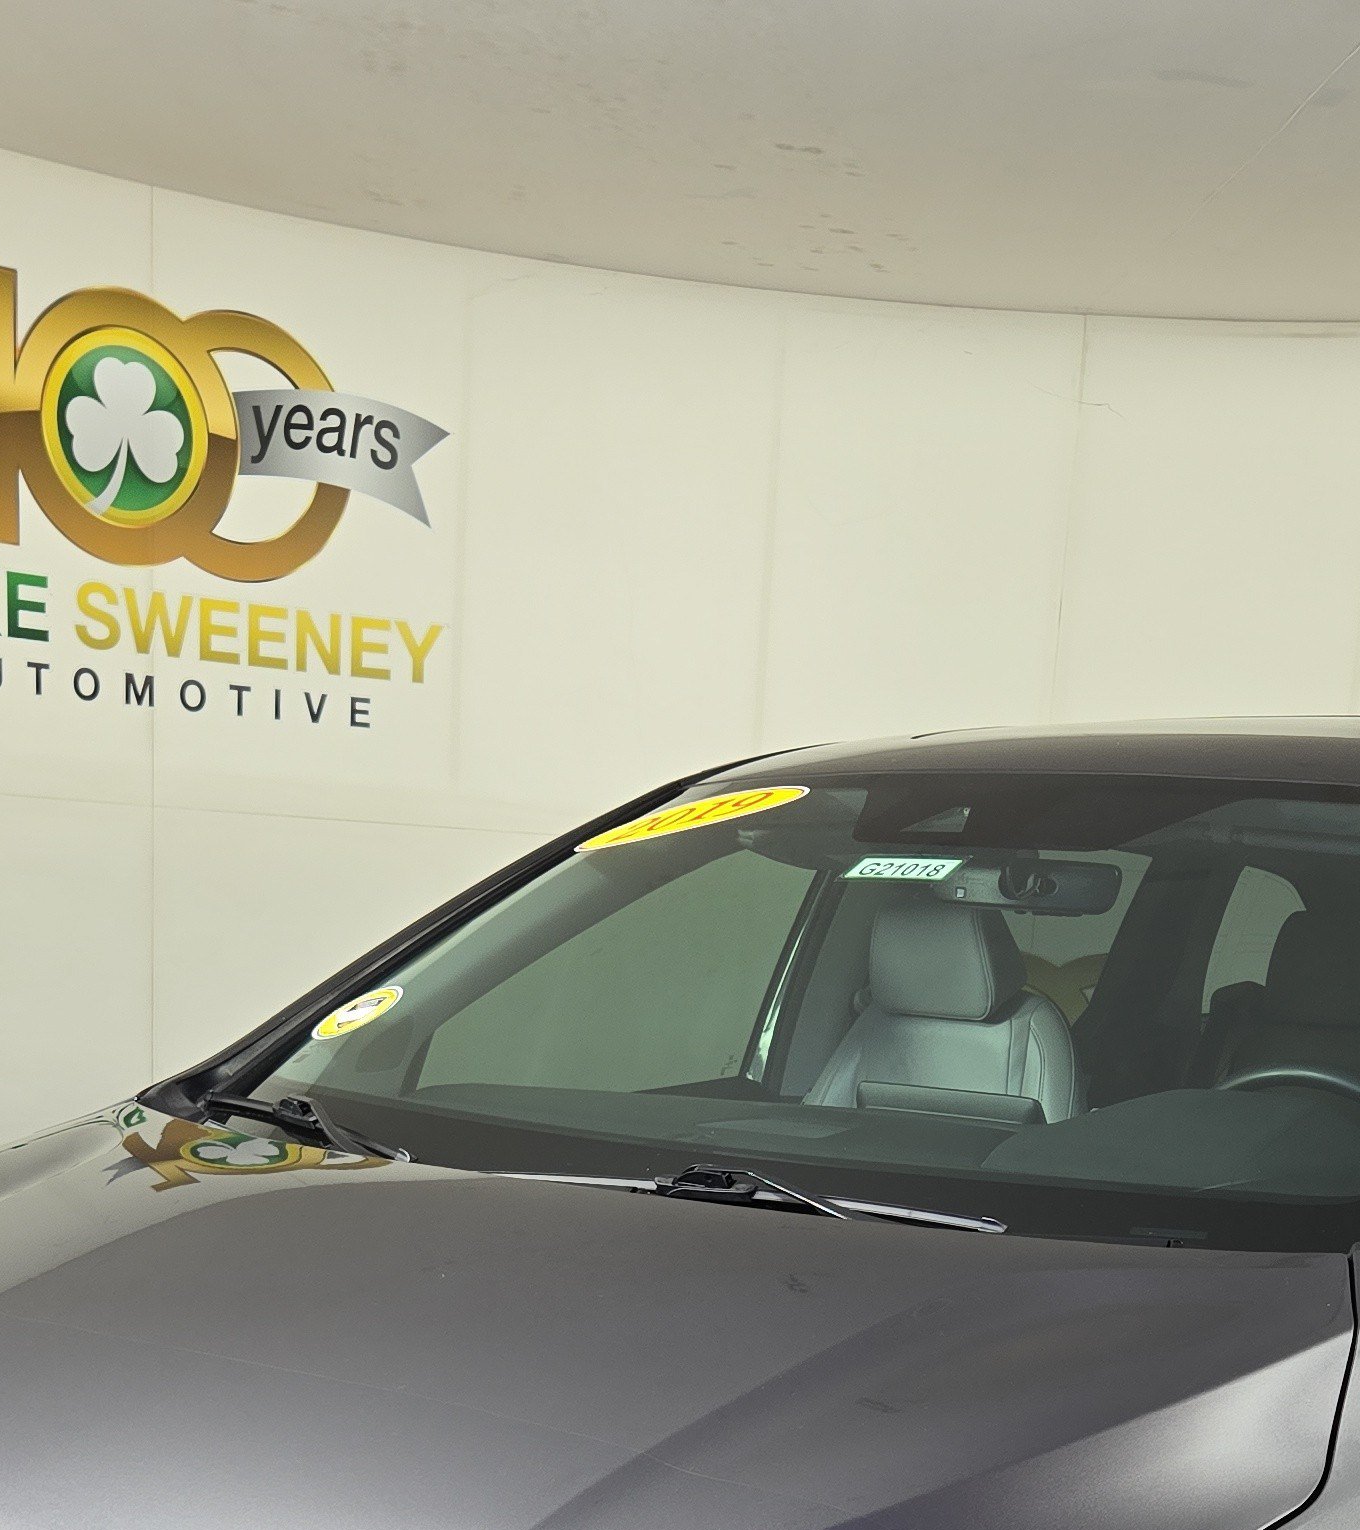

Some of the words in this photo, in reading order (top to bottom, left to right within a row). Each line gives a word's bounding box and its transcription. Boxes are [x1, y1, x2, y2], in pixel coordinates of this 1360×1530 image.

[250, 402, 400, 471] years
[73, 581, 444, 684] SWEENEY
[604, 791, 776, 845] 2019
[858, 861, 946, 878] G21018
